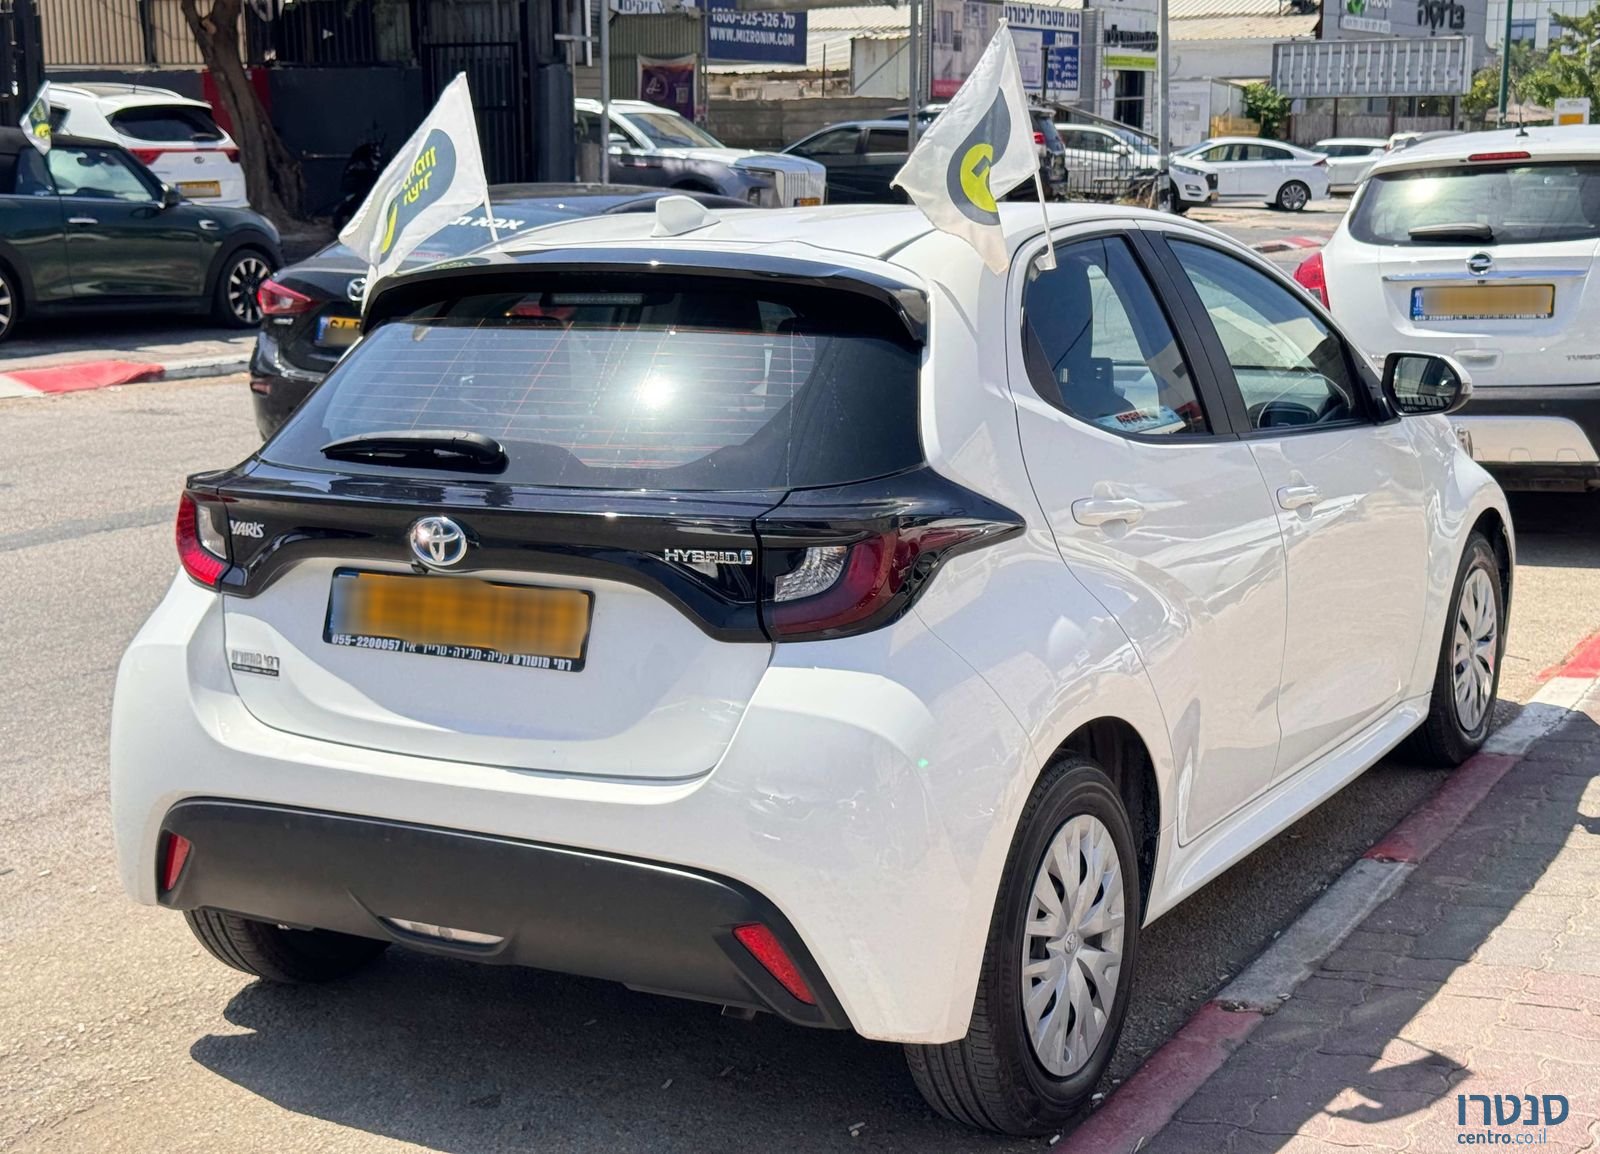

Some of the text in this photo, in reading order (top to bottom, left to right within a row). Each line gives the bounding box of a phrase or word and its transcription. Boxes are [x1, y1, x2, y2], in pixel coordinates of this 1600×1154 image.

[1037, 9, 1065, 27] מטבחי
[710, 27, 795, 46] WWW.MIZRONIM.COM
[230, 520, 265, 538] YARIS
[664, 549, 738, 564] HYBRID
[331, 634, 400, 650] 055-2200057
[512, 654, 550, 668] מוטורס
[554, 658, 572, 671] רמי
